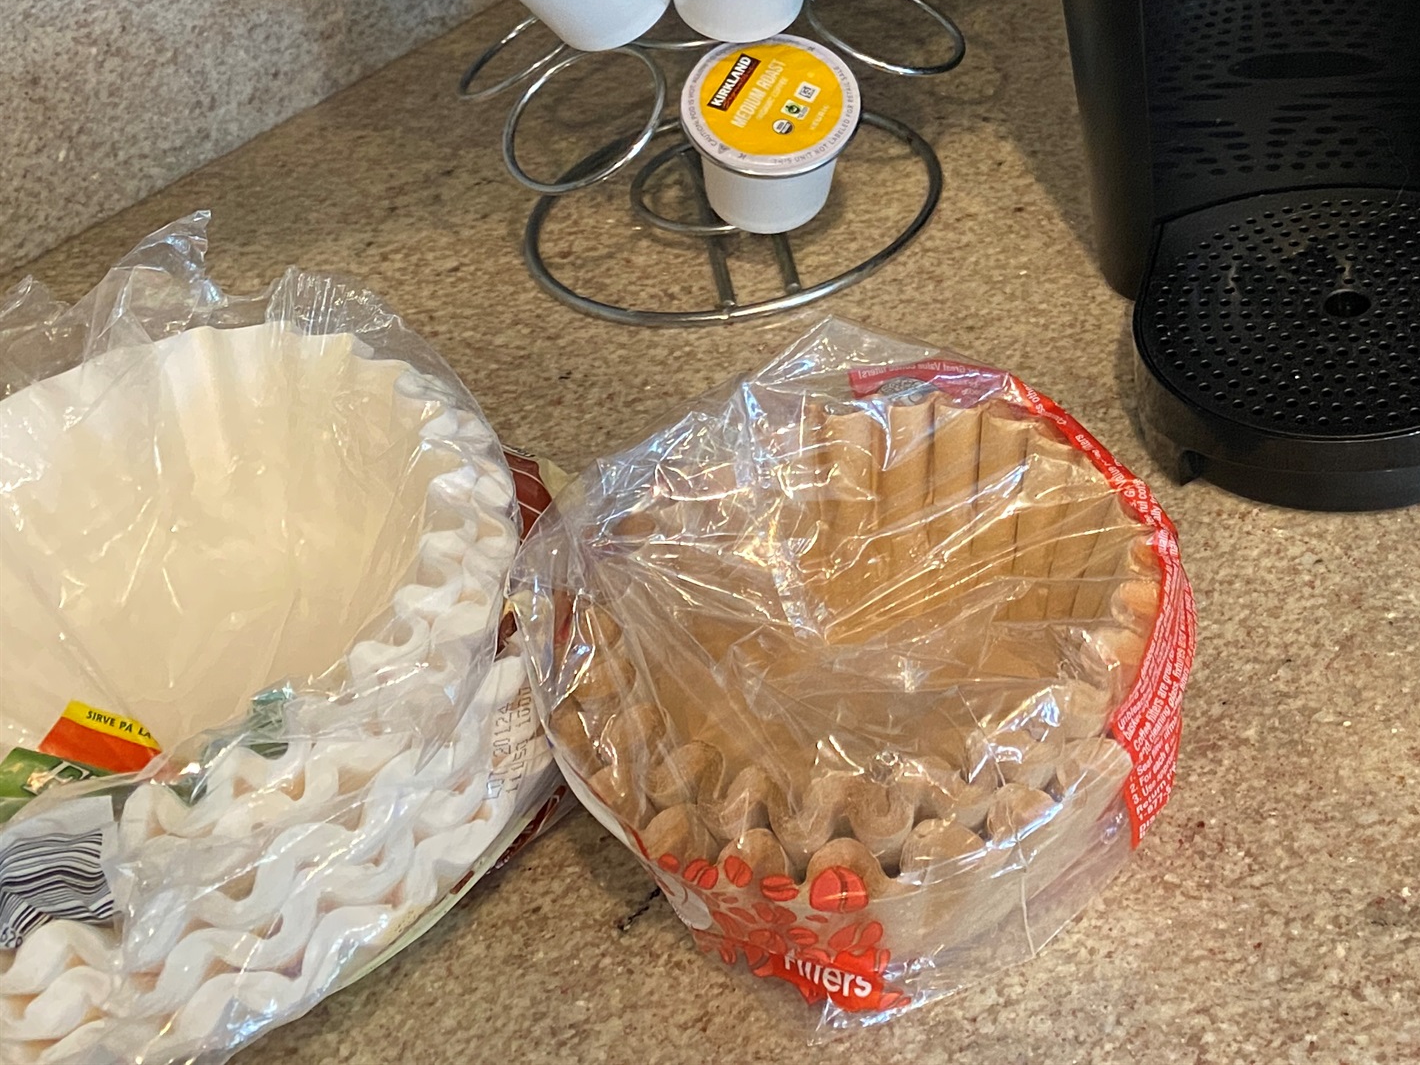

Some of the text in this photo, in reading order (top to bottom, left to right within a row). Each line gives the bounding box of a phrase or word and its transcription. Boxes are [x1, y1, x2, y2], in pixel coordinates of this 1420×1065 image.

[711, 56, 752, 106] KIRKLAND
[731, 86, 766, 129] MEDIUM
[756, 59, 787, 90] ROAST
[814, 144, 828, 155] NOT
[829, 118, 850, 145] LABELED
[86, 710, 116, 727] SIRVE
[1149, 696, 1164, 723] filters
[1157, 680, 1168, 699] are
[1149, 706, 1171, 743] cleaning
[1129, 785, 1138, 794] 2.
[1139, 772, 1152, 788] For
[1132, 778, 1157, 804] 3. Use
[1136, 780, 1167, 815] Return
